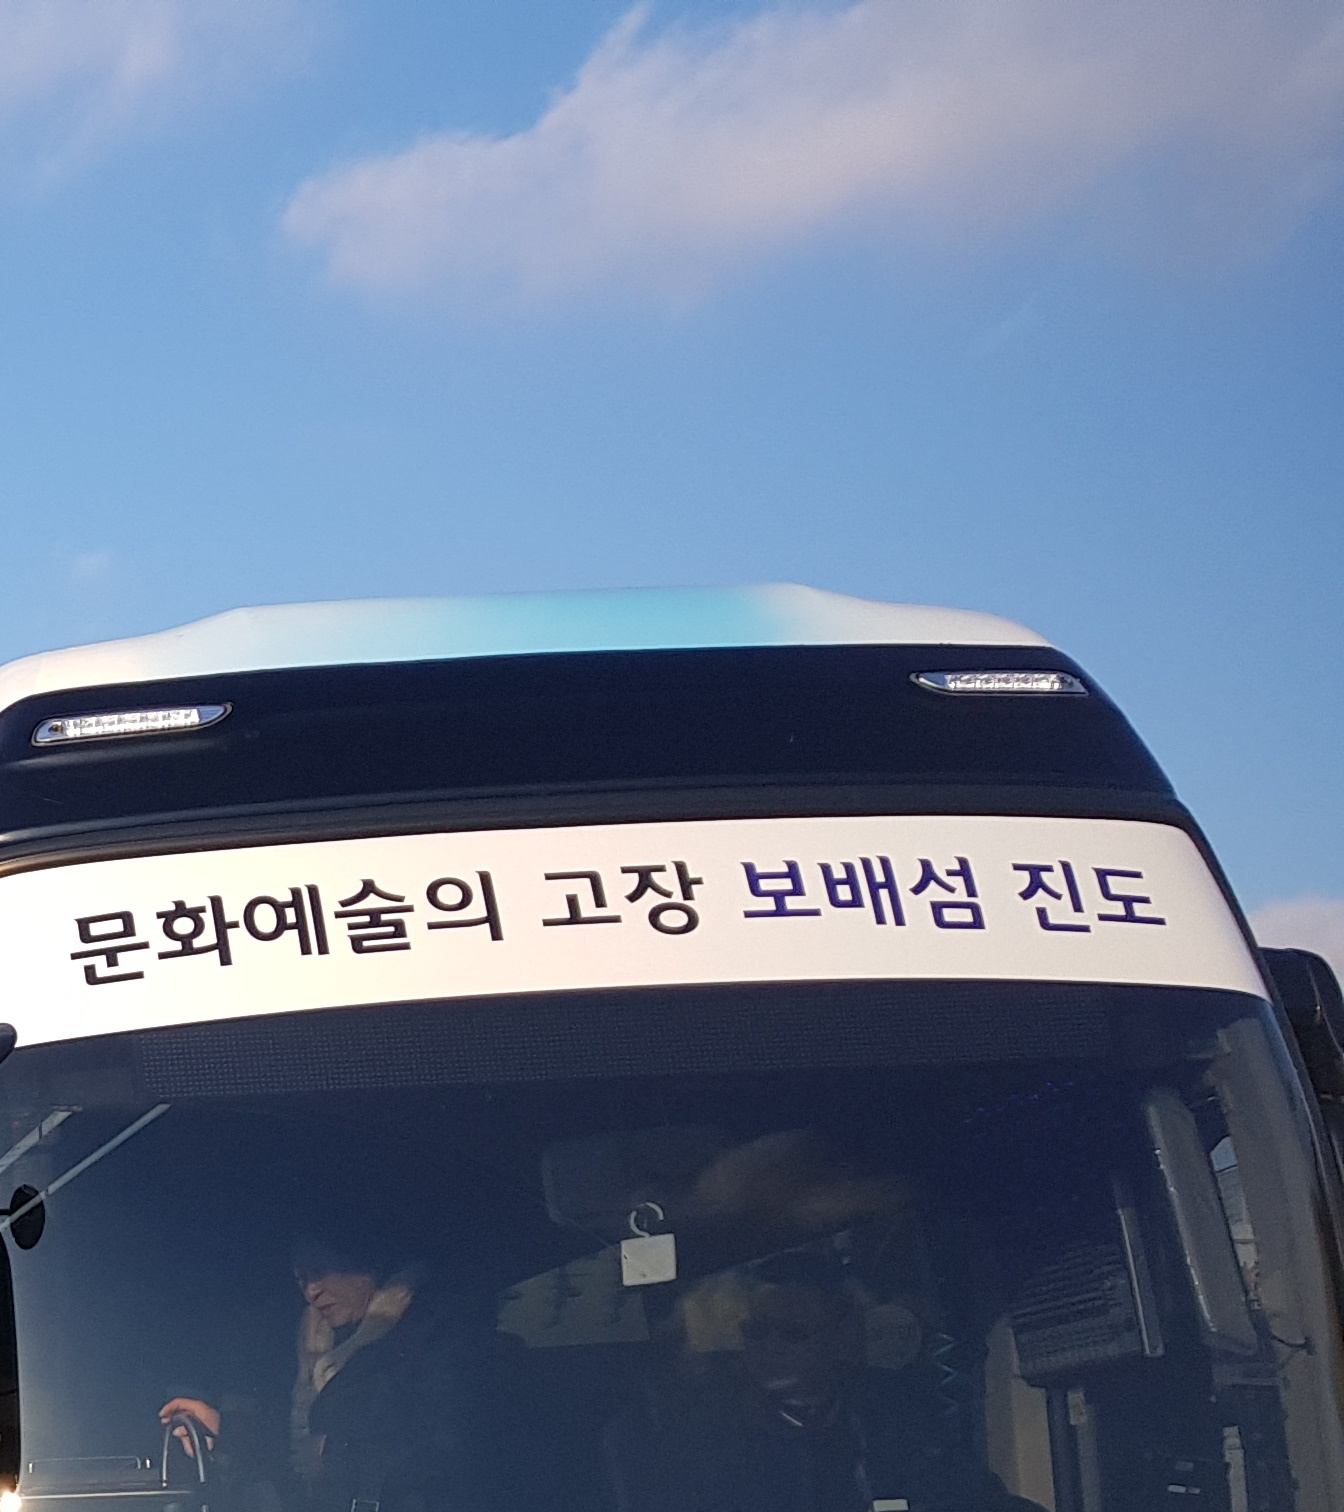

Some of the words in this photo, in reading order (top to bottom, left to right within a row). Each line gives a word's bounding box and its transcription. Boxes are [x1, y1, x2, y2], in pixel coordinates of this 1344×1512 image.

[69, 869, 504, 987] 문화예술의
[542, 860, 704, 936] 고장
[740, 855, 987, 931] 보배섬
[1011, 859, 1167, 934] 진도
